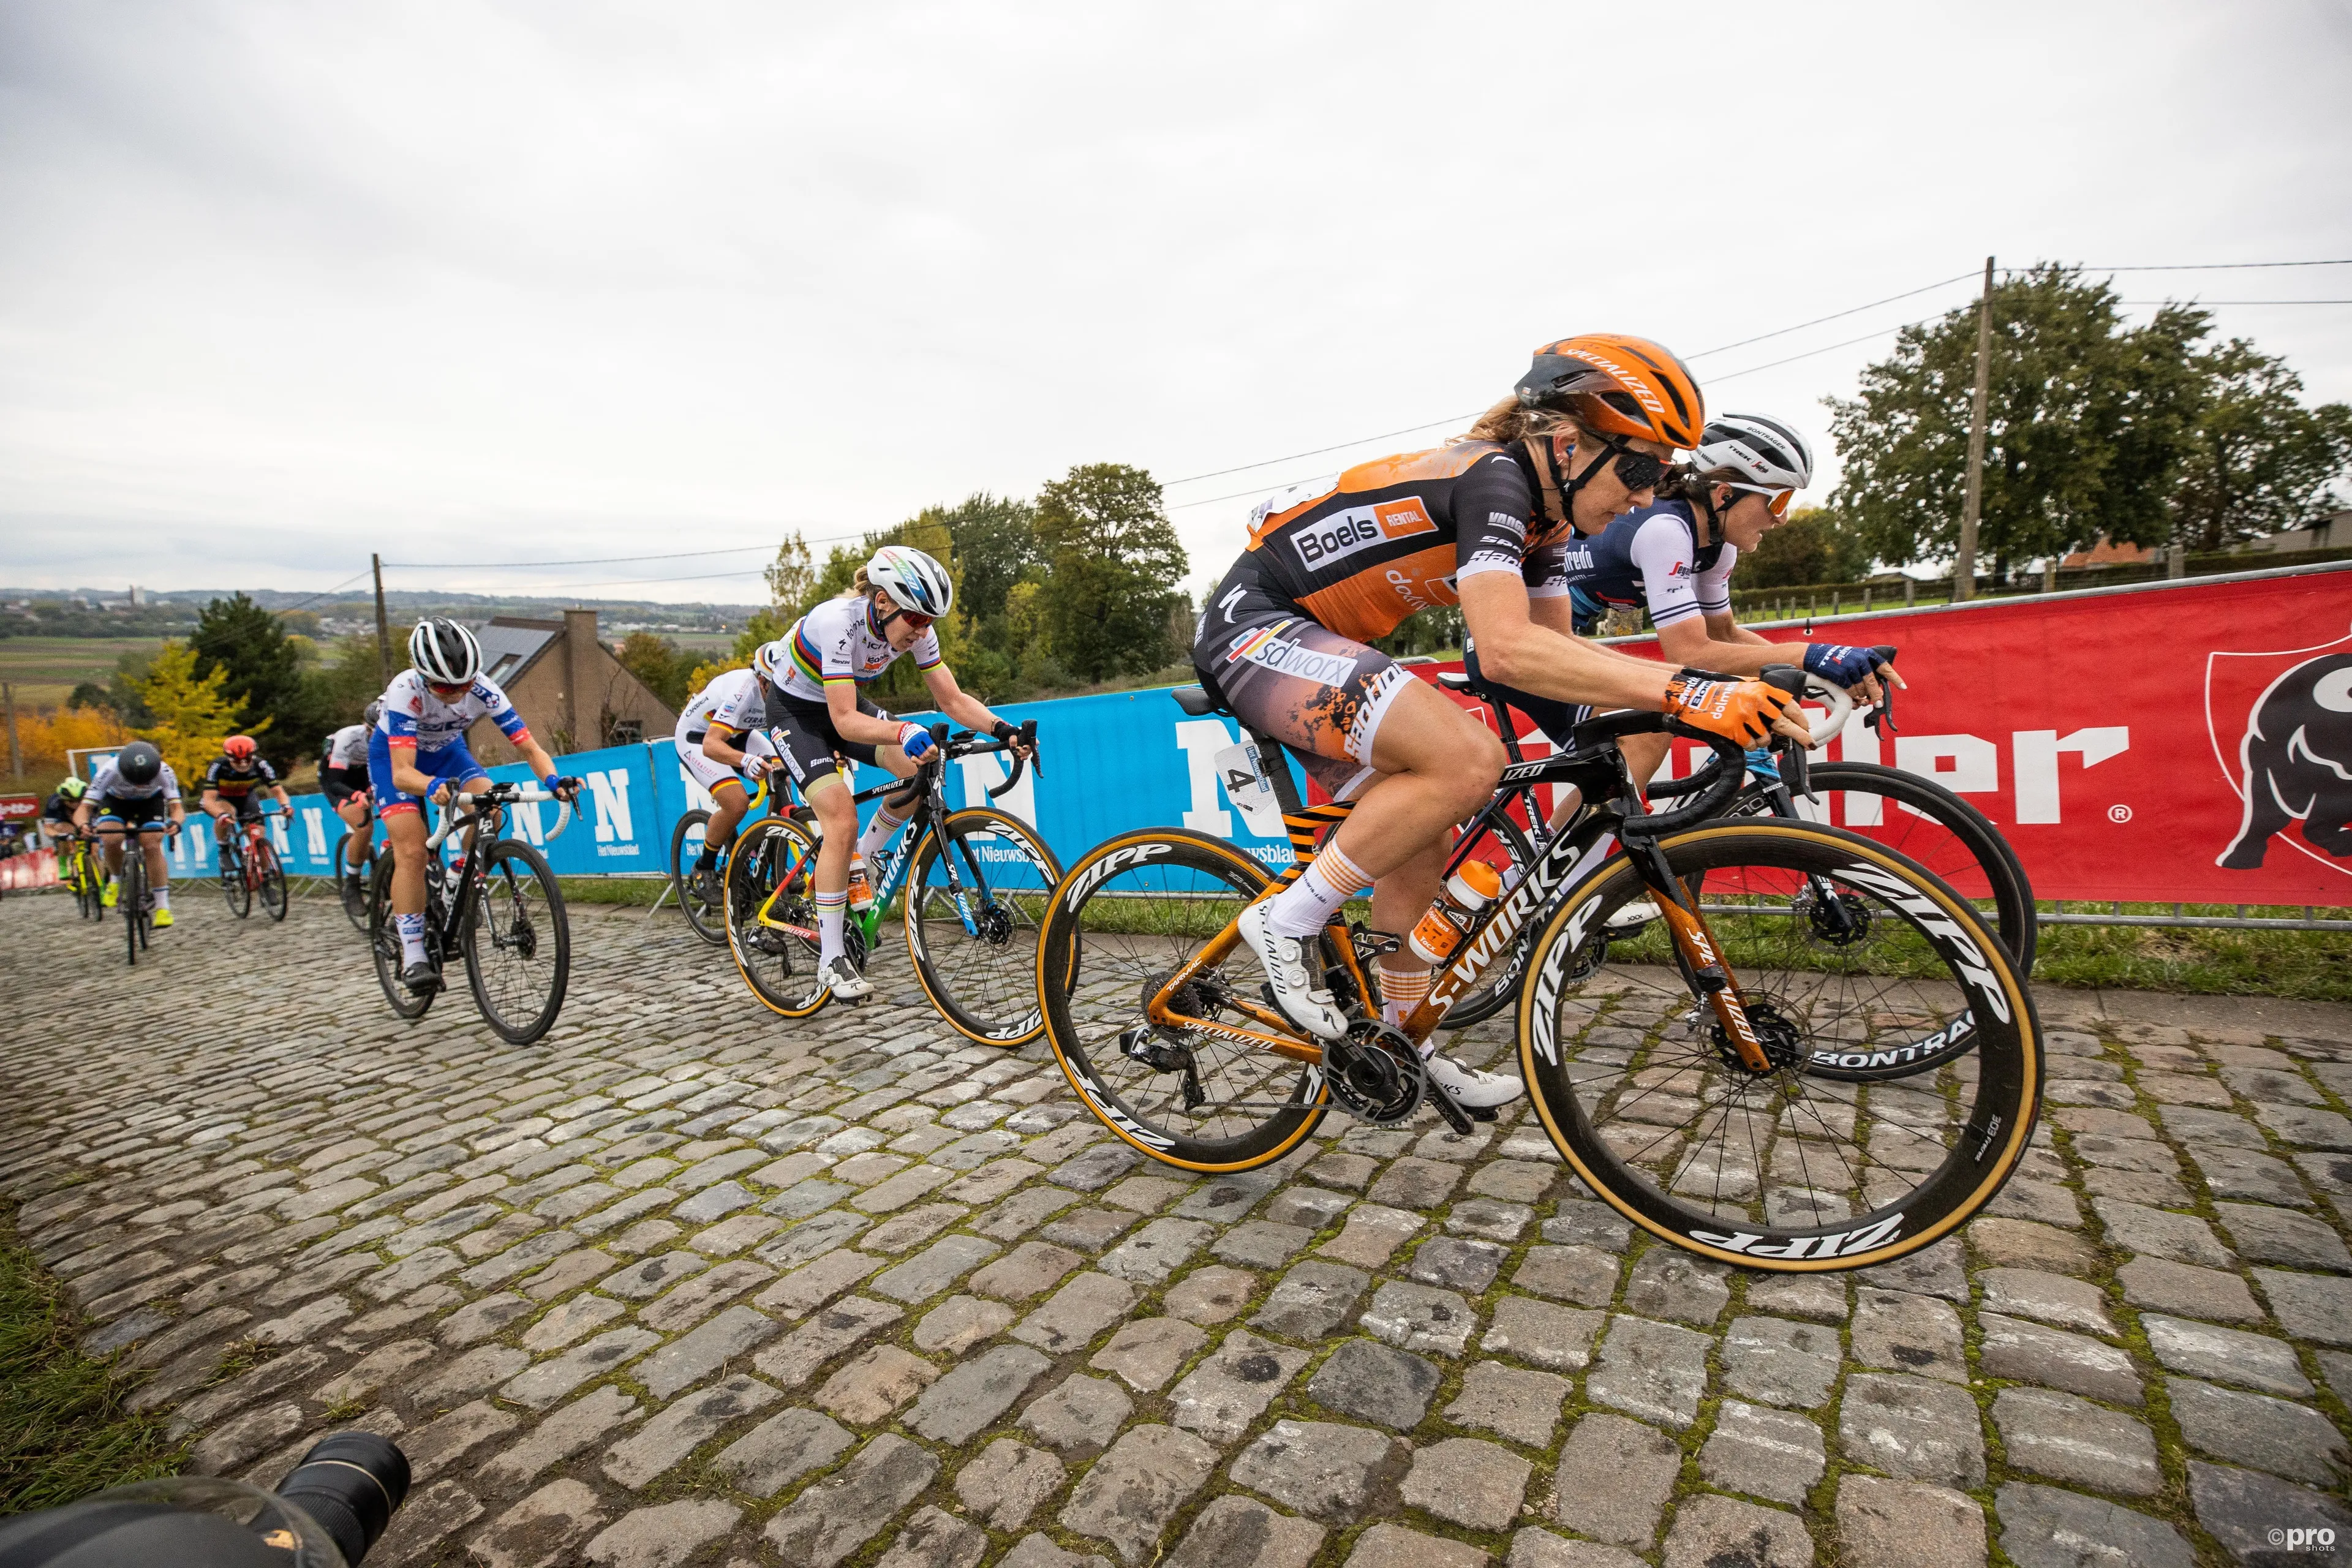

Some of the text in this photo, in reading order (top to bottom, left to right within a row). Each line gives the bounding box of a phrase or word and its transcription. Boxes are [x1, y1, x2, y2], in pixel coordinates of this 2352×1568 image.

[1564, 349, 1665, 413] SPECIALIZED
[1728, 444, 1752, 462] TREK
[1747, 427, 1786, 450] BONTRAGER
[1297, 510, 1423, 563] Boels RENTAL
[1255, 640, 1351, 684] sdworx
[1710, 681, 1739, 720] dolman
[777, 739, 804, 781] sdworx
[1227, 769, 1257, 793] 4
[1246, 747, 1268, 792] Het Nieuwsblad
[586, 767, 638, 842] N
[872, 779, 905, 794] SPECIALIZED
[506, 780, 544, 846] N
[1525, 798, 1542, 835] TREK
[870, 822, 918, 919] S-WORKS
[981, 846, 1033, 862] Nieuwsb
[985, 820, 1054, 886] ZIPP
[1066, 843, 1172, 913] ZIPP
[909, 865, 925, 962] ZIPP
[1428, 910, 1450, 932] dolmans
[1428, 831, 1581, 1019] S-WORKS
[1419, 937, 1436, 951] Tacx
[1831, 863, 2010, 1024] ZIPP
[1166, 956, 1203, 992] TARMAC
[1534, 894, 1603, 1066] ZIPP
[1181, 1021, 1277, 1050] SPECIALIZED
[1066, 1056, 1175, 1151] ZIPP
[1689, 1212, 1905, 1259] ZIPP
